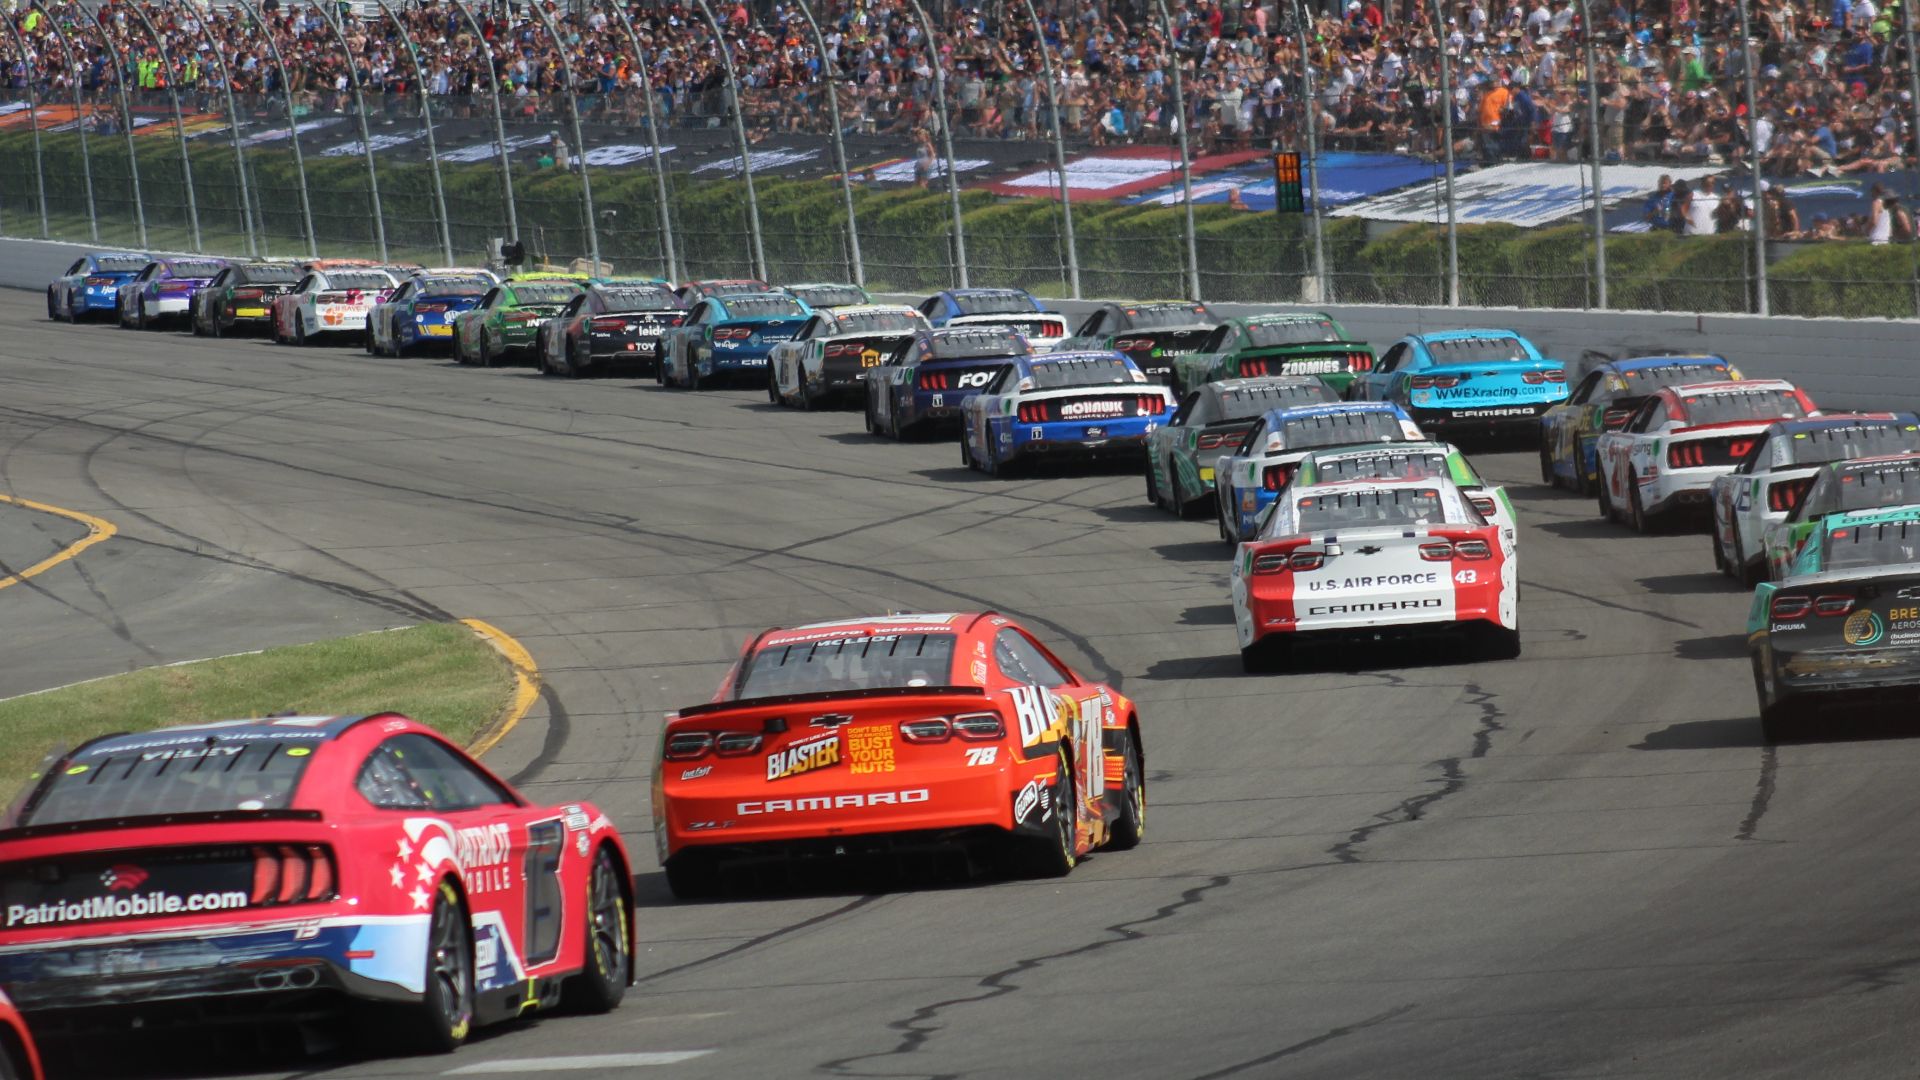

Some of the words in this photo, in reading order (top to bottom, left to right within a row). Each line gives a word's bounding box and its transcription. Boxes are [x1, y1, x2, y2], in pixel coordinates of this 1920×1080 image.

[1436, 386, 1546, 400] WWEXracing.com
[1060, 401, 1124, 415] MOHAWK
[1452, 407, 1535, 417] CAMARO
[1309, 578, 1341, 592] U.S.
[1346, 575, 1374, 588] AIR
[1377, 572, 1437, 586] FORCE
[1454, 569, 1477, 584] 43
[1309, 598, 1442, 616] CAMARO
[1890, 606, 1920, 621] BRE
[848, 735, 894, 751] BUST
[767, 736, 839, 781] BLASTER
[850, 748, 895, 762] YOUR
[965, 746, 998, 766] 78
[850, 759, 895, 774] NUTS
[737, 788, 929, 815] CAMARO
[466, 866, 512, 896] OBILE
[5, 891, 248, 926] PatriotMobile.com
